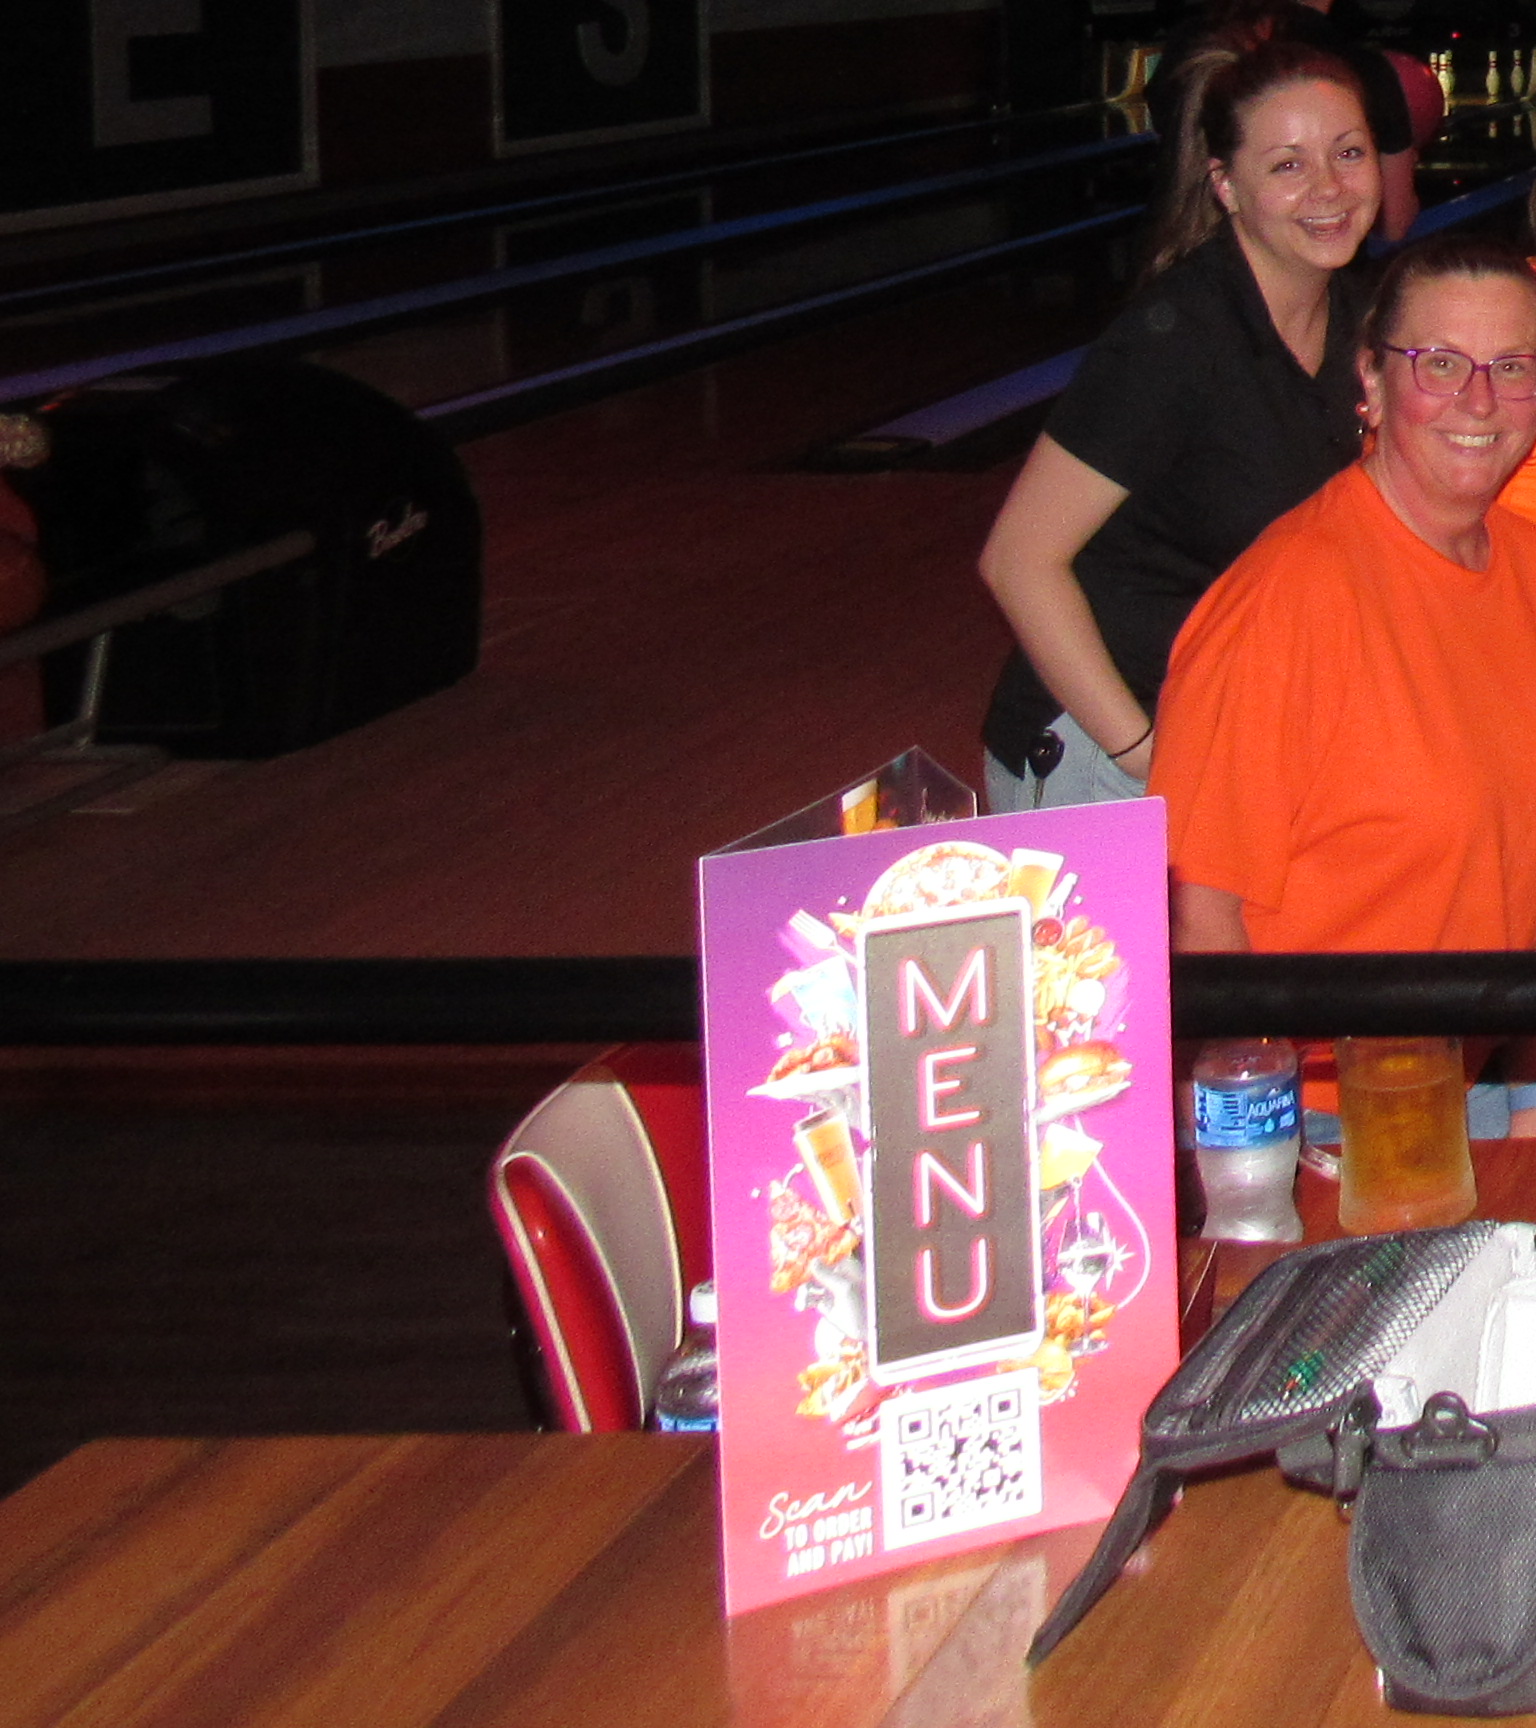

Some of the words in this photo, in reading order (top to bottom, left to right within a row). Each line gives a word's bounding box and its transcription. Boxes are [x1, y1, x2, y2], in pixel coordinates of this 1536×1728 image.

[899, 946, 996, 1324] MENU
[760, 1481, 873, 1539] Scan
[784, 1523, 809, 1552] TO
[813, 1506, 873, 1543] ORDER
[787, 1544, 826, 1577] AND
[830, 1531, 873, 1566] PAY!
